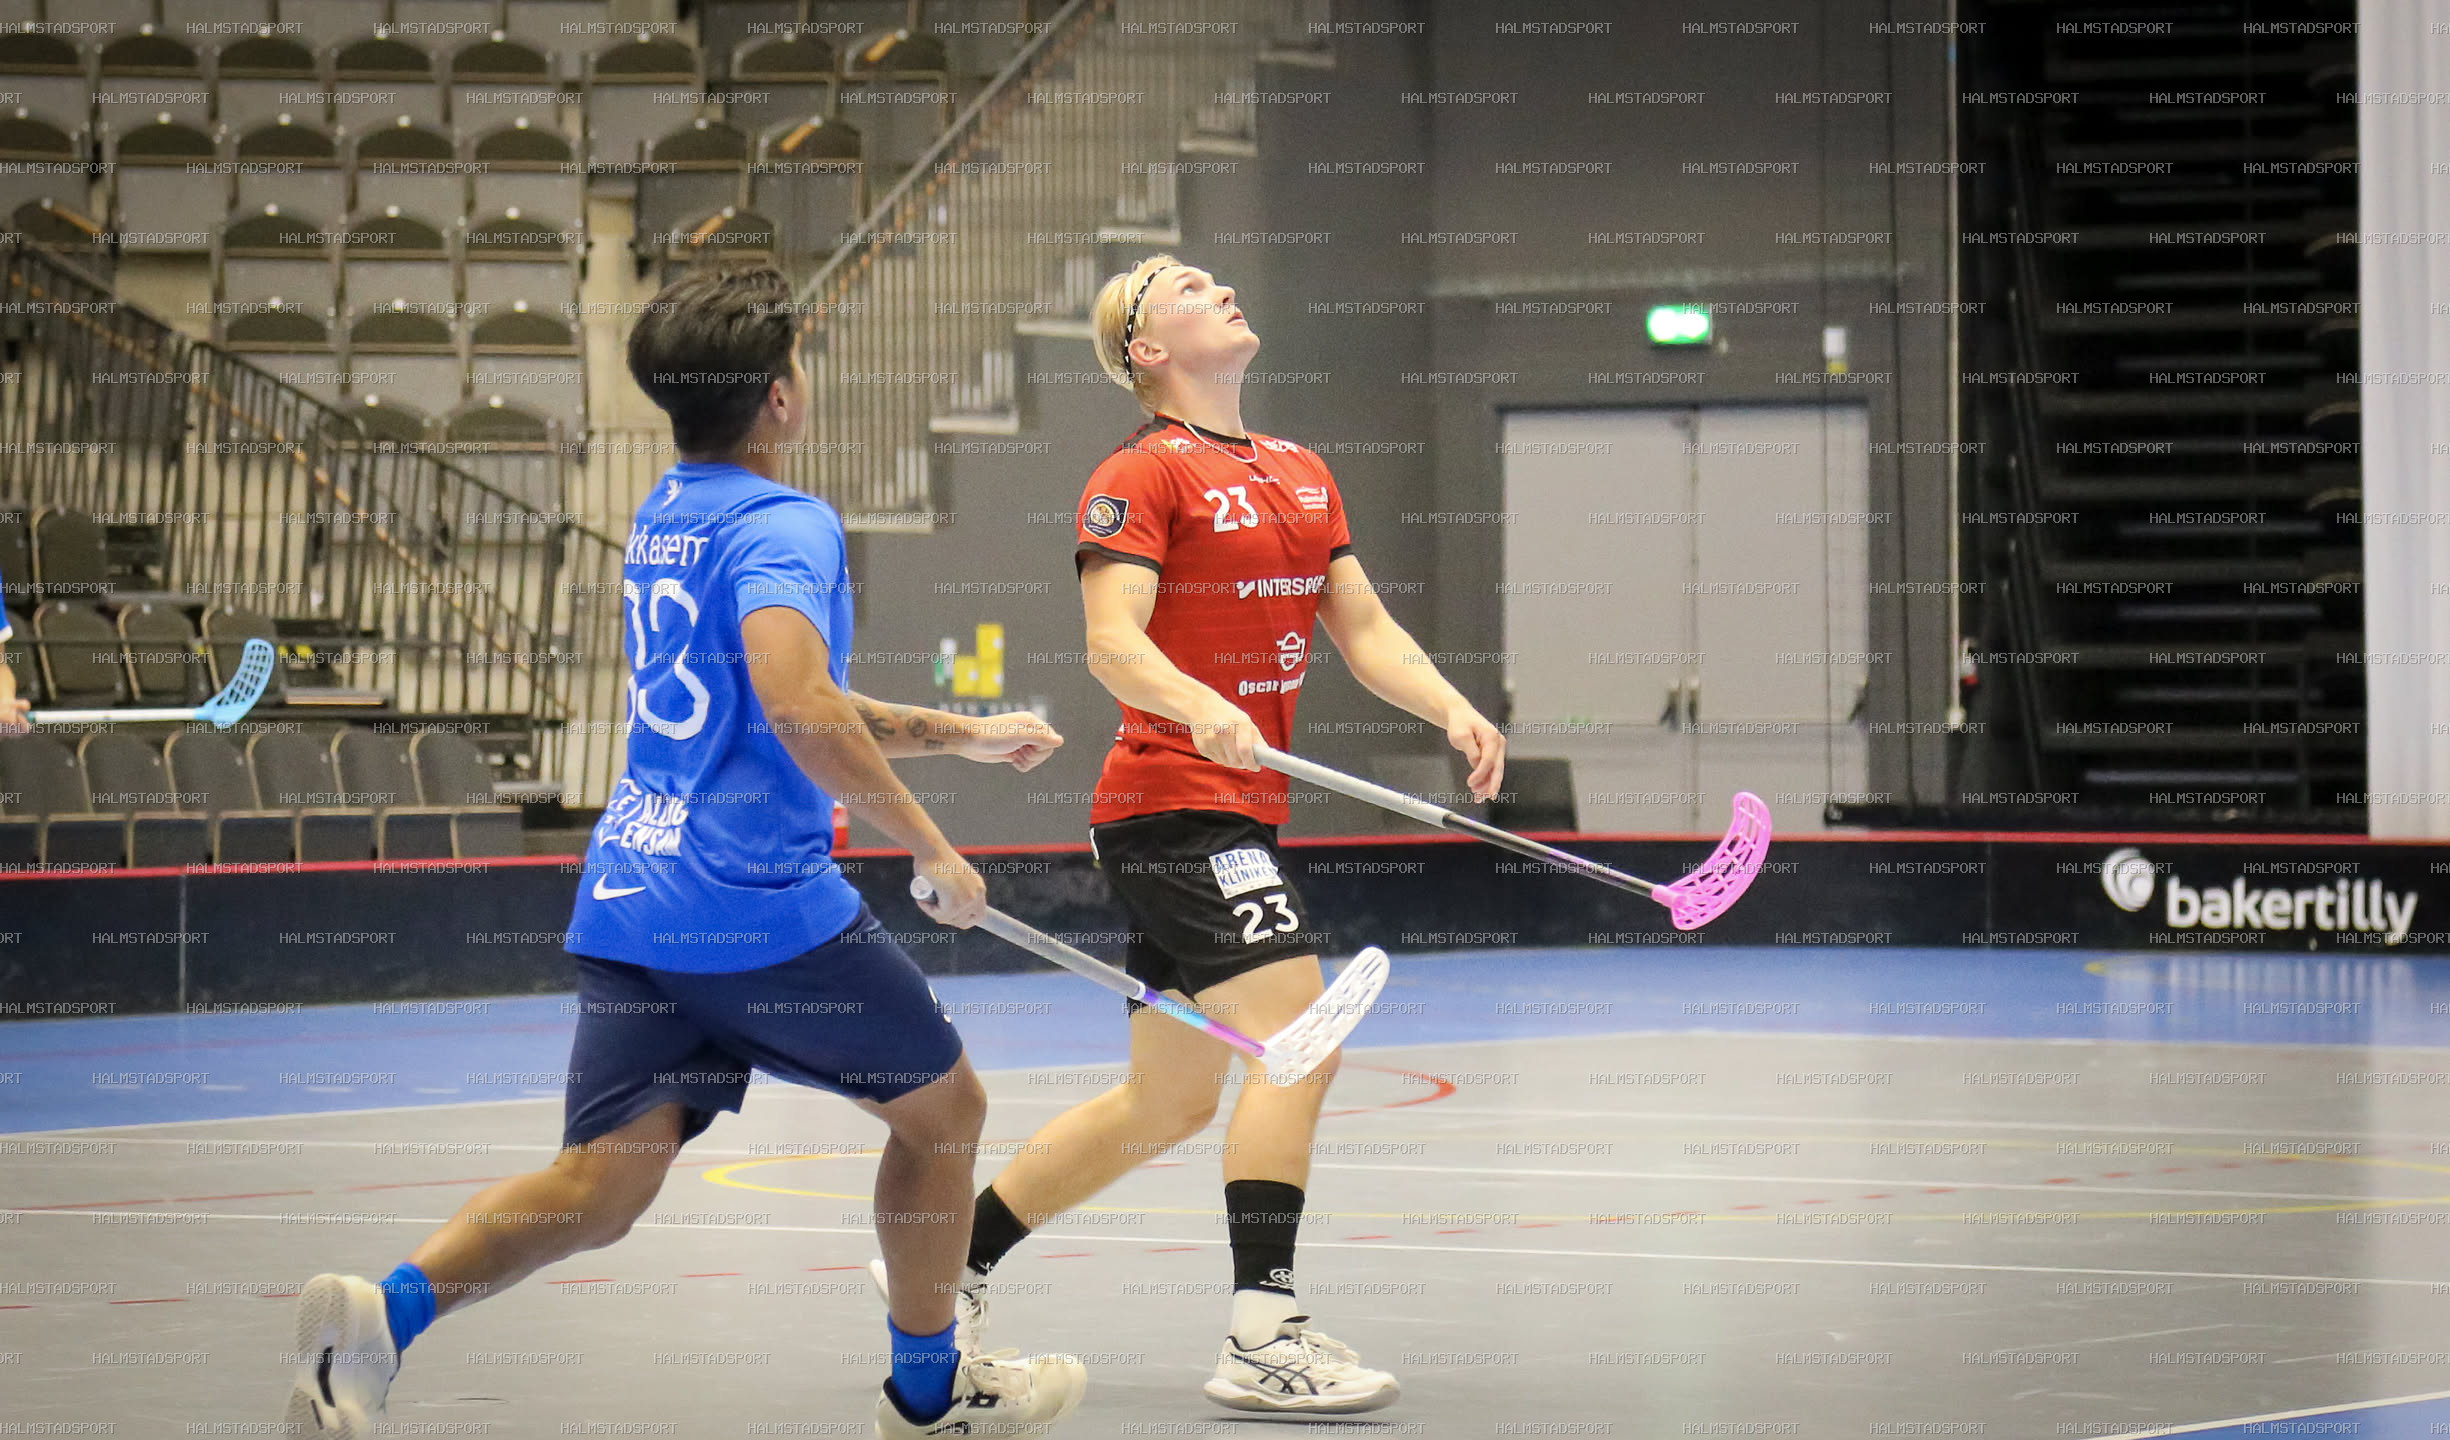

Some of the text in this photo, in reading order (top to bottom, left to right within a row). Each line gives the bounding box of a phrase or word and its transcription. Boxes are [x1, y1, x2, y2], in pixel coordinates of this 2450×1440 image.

[1203, 485, 1260, 534] 23
[1238, 680, 1280, 697] Oscar
[1214, 850, 1270, 873] ARENA
[1232, 893, 1300, 945] 23
